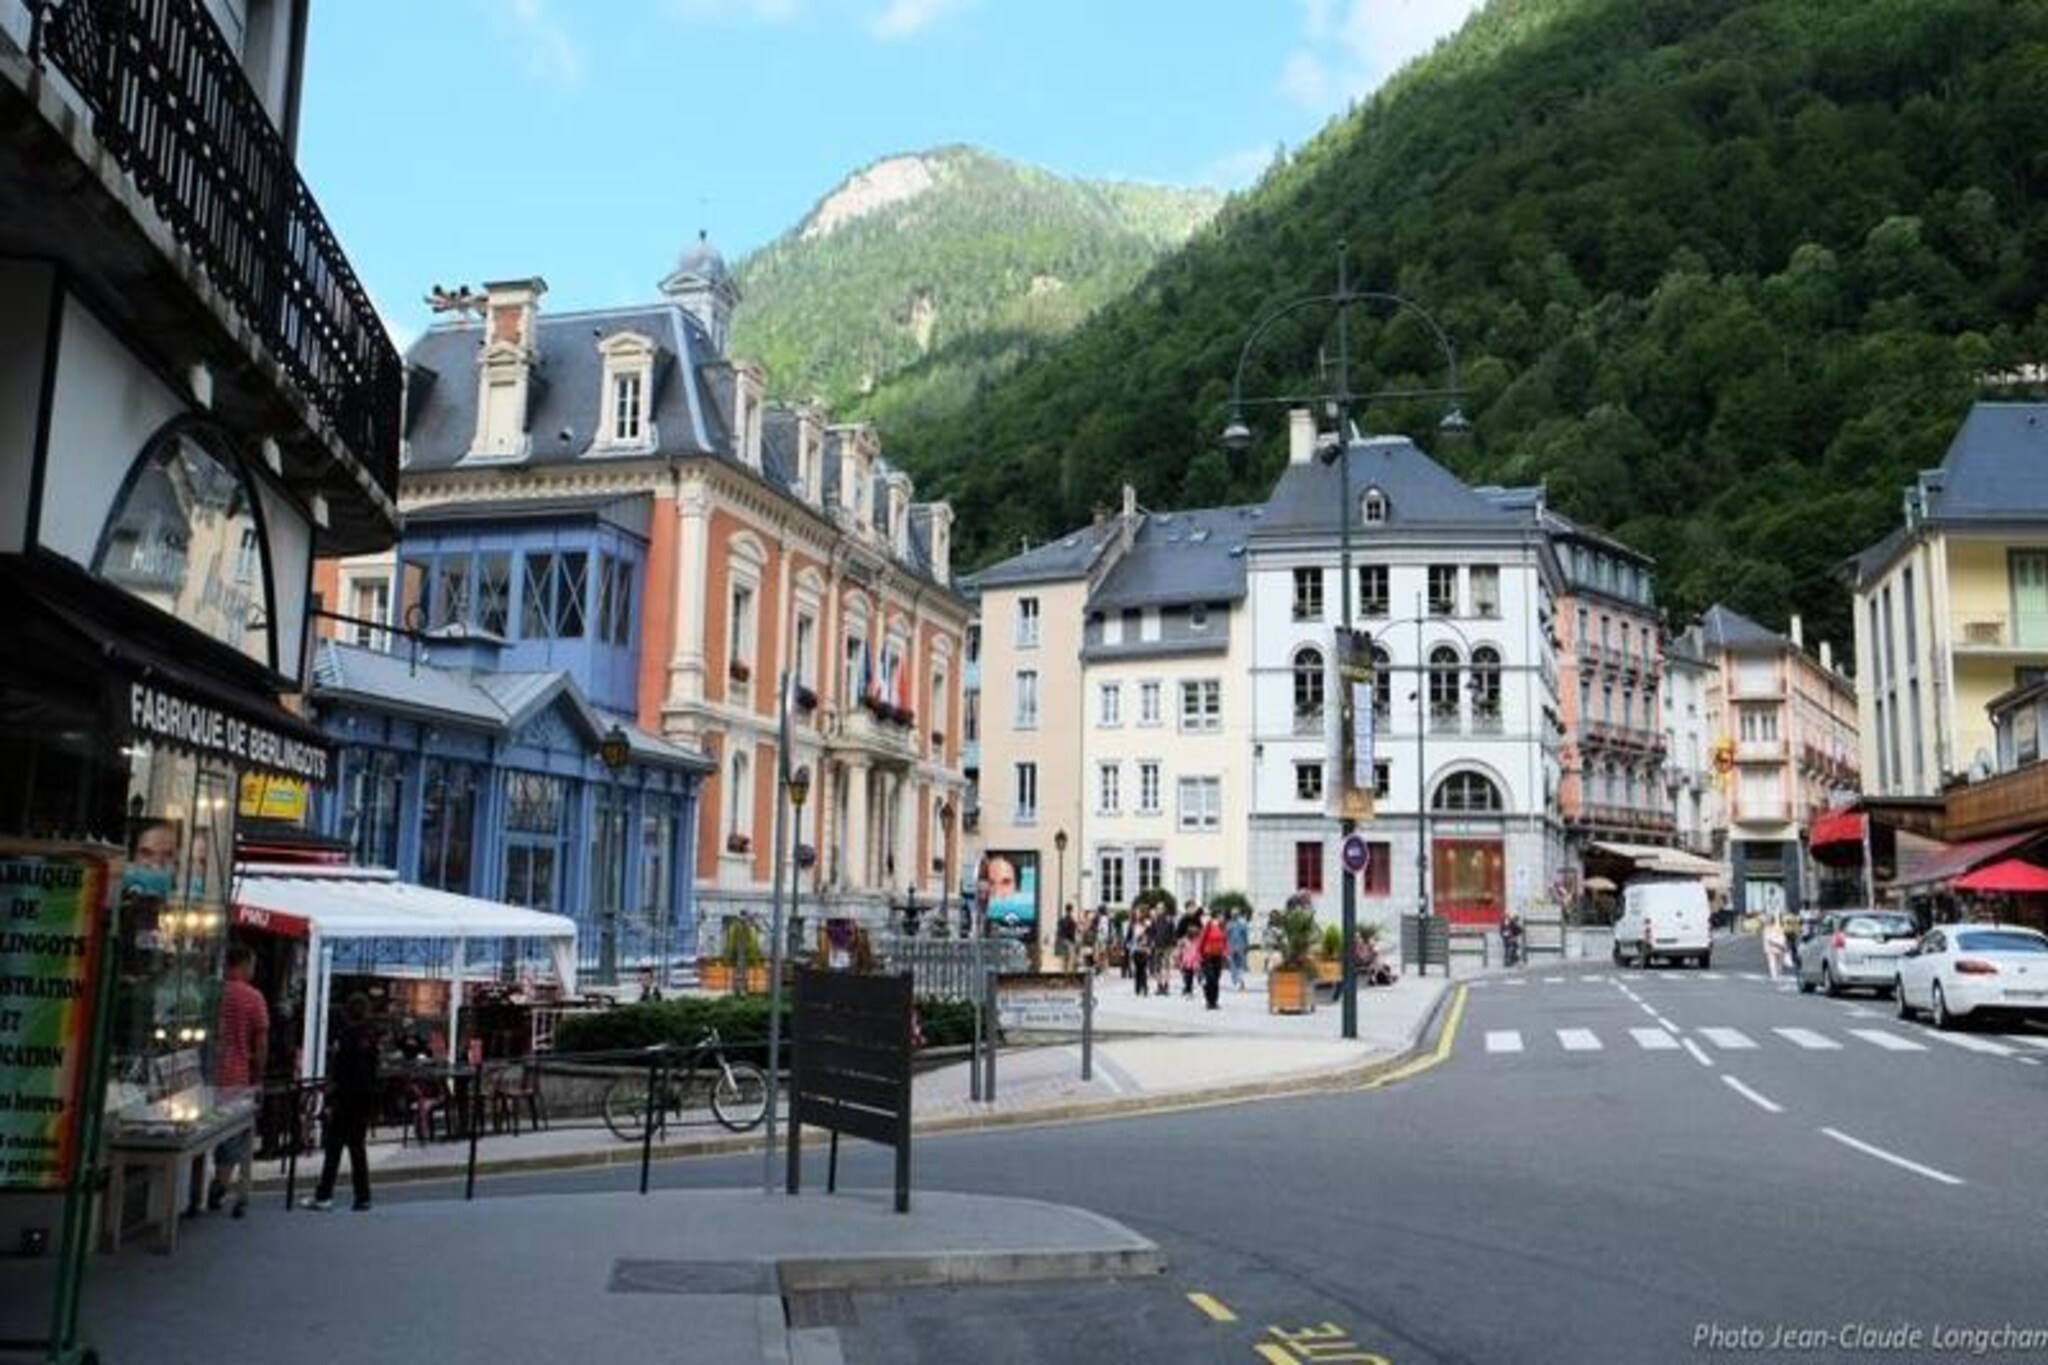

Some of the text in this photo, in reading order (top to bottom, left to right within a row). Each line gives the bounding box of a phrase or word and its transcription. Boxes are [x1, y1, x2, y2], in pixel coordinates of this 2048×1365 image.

[131, 682, 327, 781] FABRIQUE DE BERLINGOTS
[11, 897, 40, 919] DE
